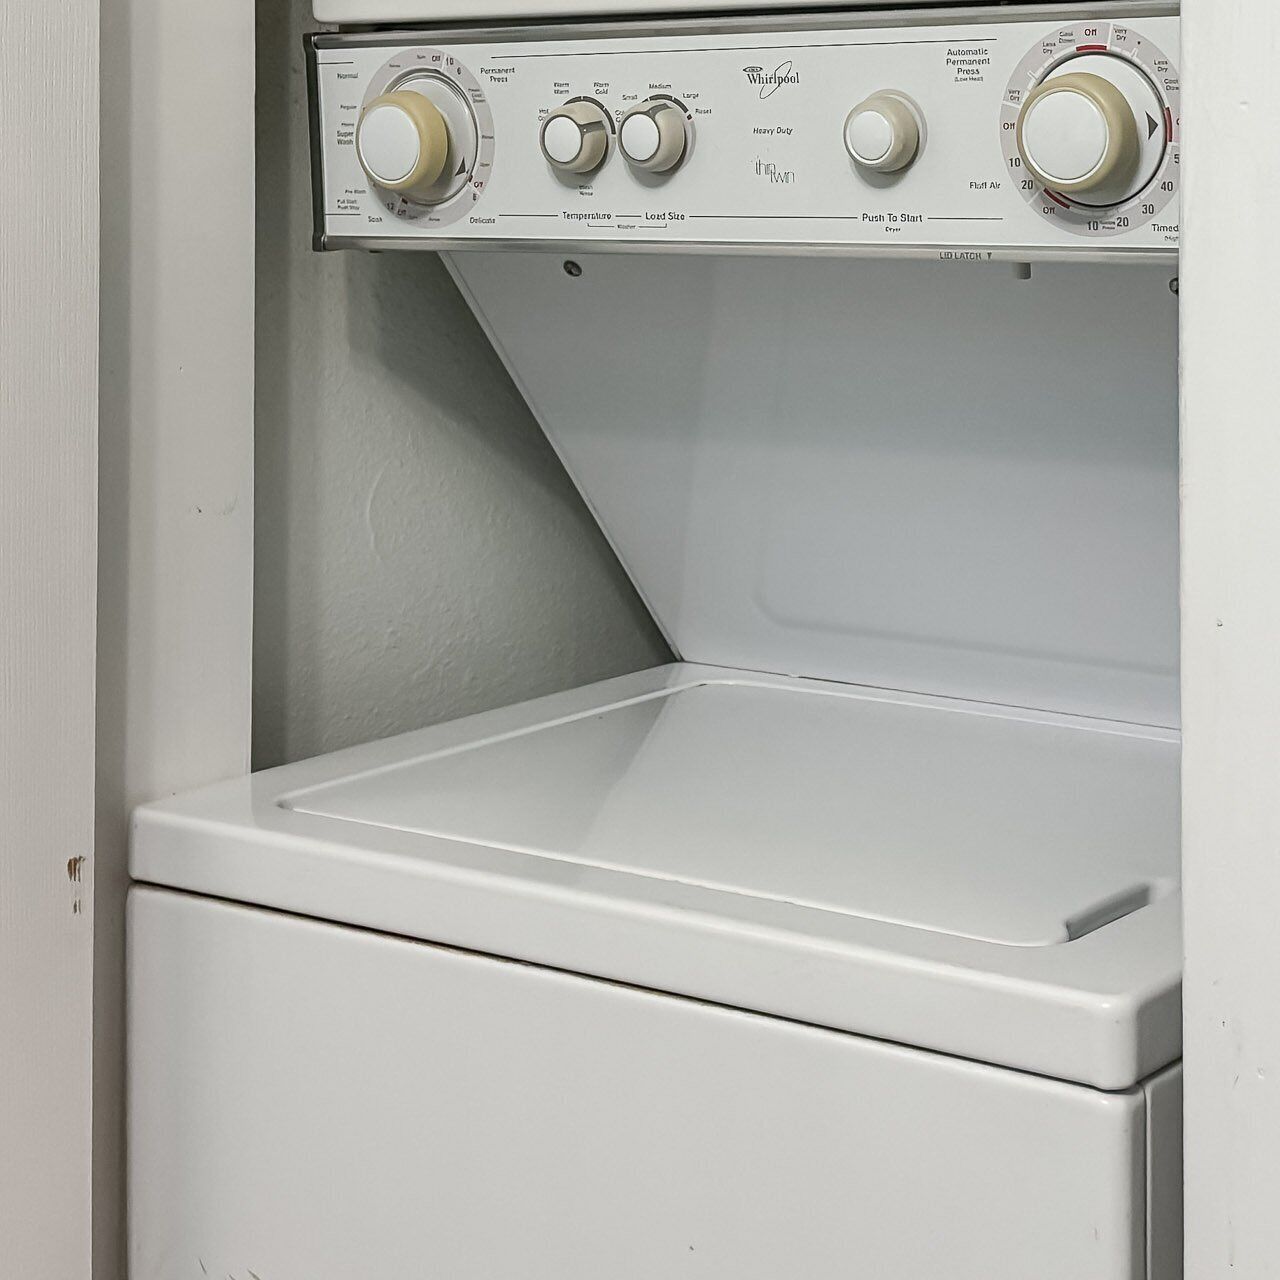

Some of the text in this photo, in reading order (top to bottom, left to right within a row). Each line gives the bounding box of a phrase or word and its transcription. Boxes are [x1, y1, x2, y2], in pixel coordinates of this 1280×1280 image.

[1084, 28, 1097, 36] Off
[947, 48, 988, 56] Automatic
[946, 58, 990, 66] Permanent
[957, 67, 980, 75] Press
[489, 75, 508, 83] Press
[746, 69, 800, 87] Whirlpool
[753, 126, 793, 135] Heavy Duty
[1003, 122, 1015, 130] Off
[1009, 157, 1021, 167] 10
[1021, 180, 1033, 190] 20
[1160, 181, 1174, 191] 40
[1042, 206, 1055, 214] Off
[1142, 204, 1154, 214] 30
[562, 211, 612, 221] Temperature
[645, 211, 685, 221] Load Size
[862, 213, 923, 223] Push To Start
[1087, 221, 1099, 230] 10
[1116, 217, 1129, 227] 20
[1151, 224, 1179, 232] Timed
[939, 252, 982, 260] LID LATCH
